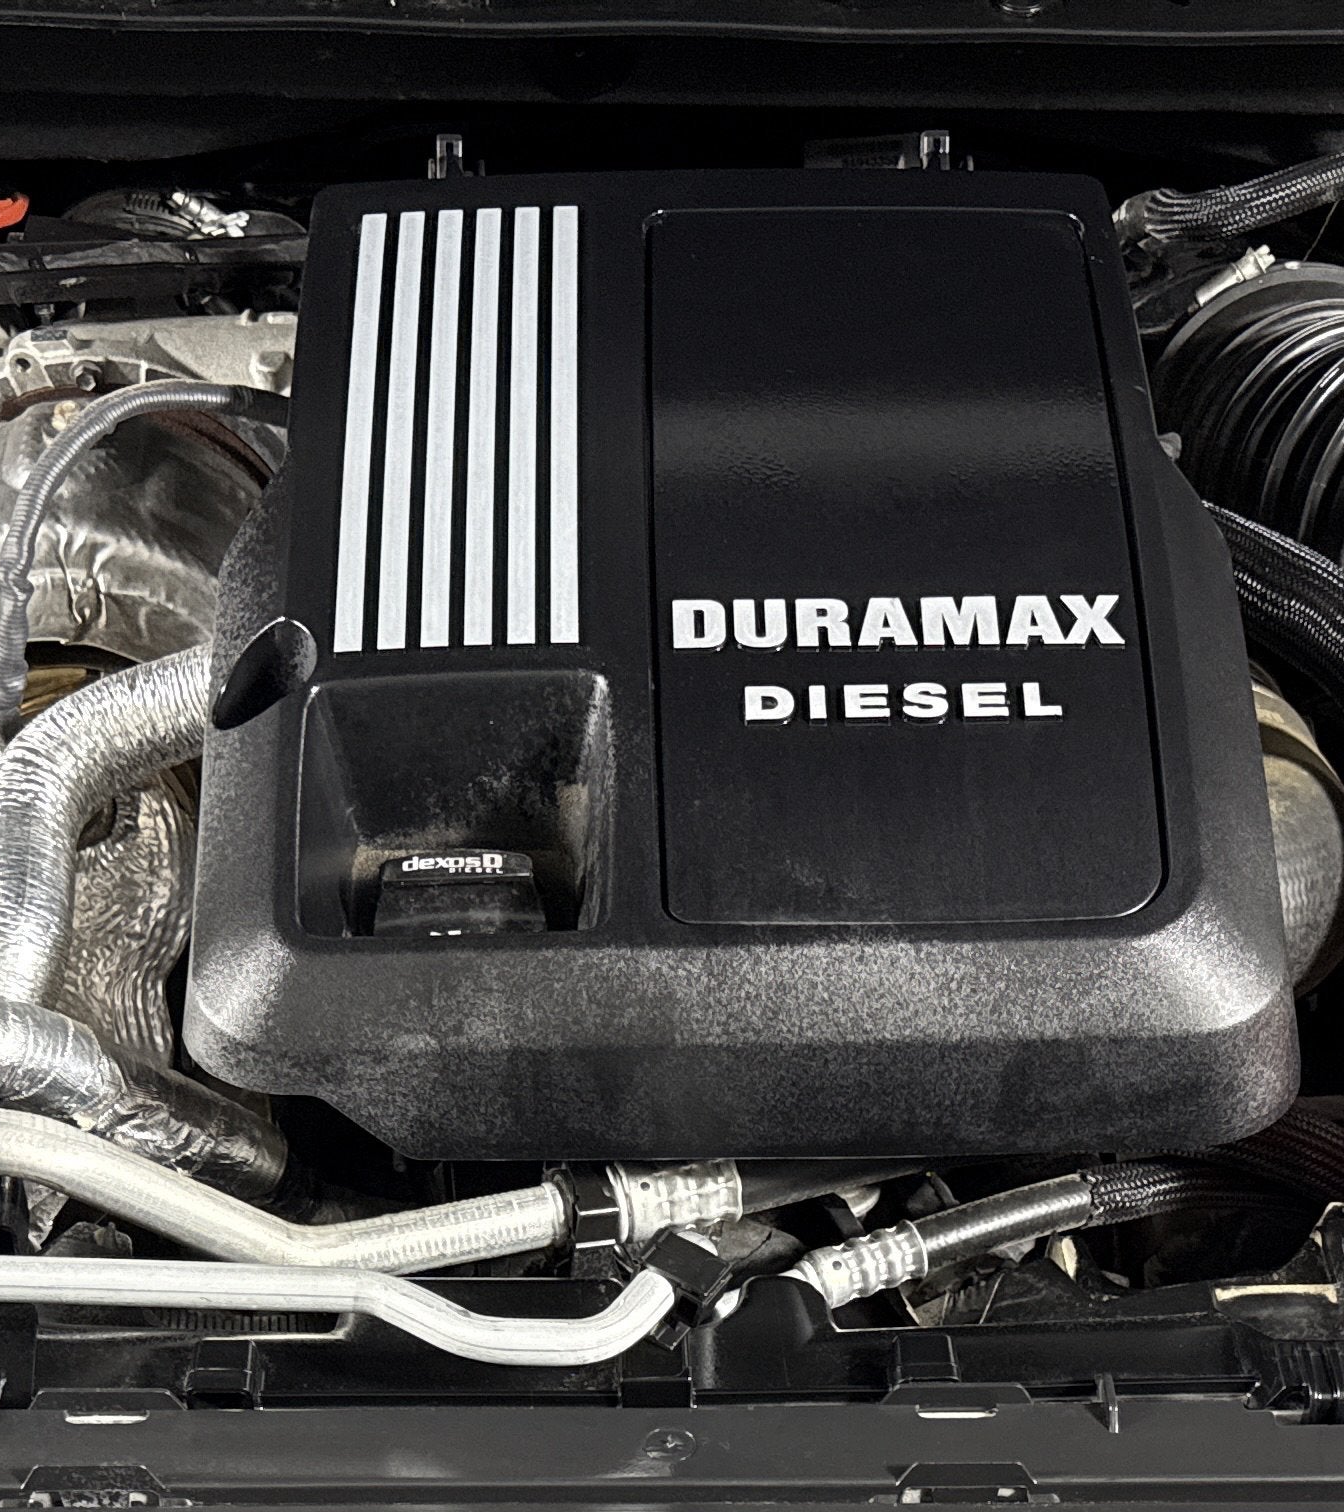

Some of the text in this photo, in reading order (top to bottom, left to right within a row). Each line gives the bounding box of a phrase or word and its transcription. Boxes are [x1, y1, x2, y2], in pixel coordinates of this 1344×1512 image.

[671, 594, 1125, 651] DURAMAX
[744, 681, 1063, 725] DIESEL
[402, 853, 504, 872] dexosD
